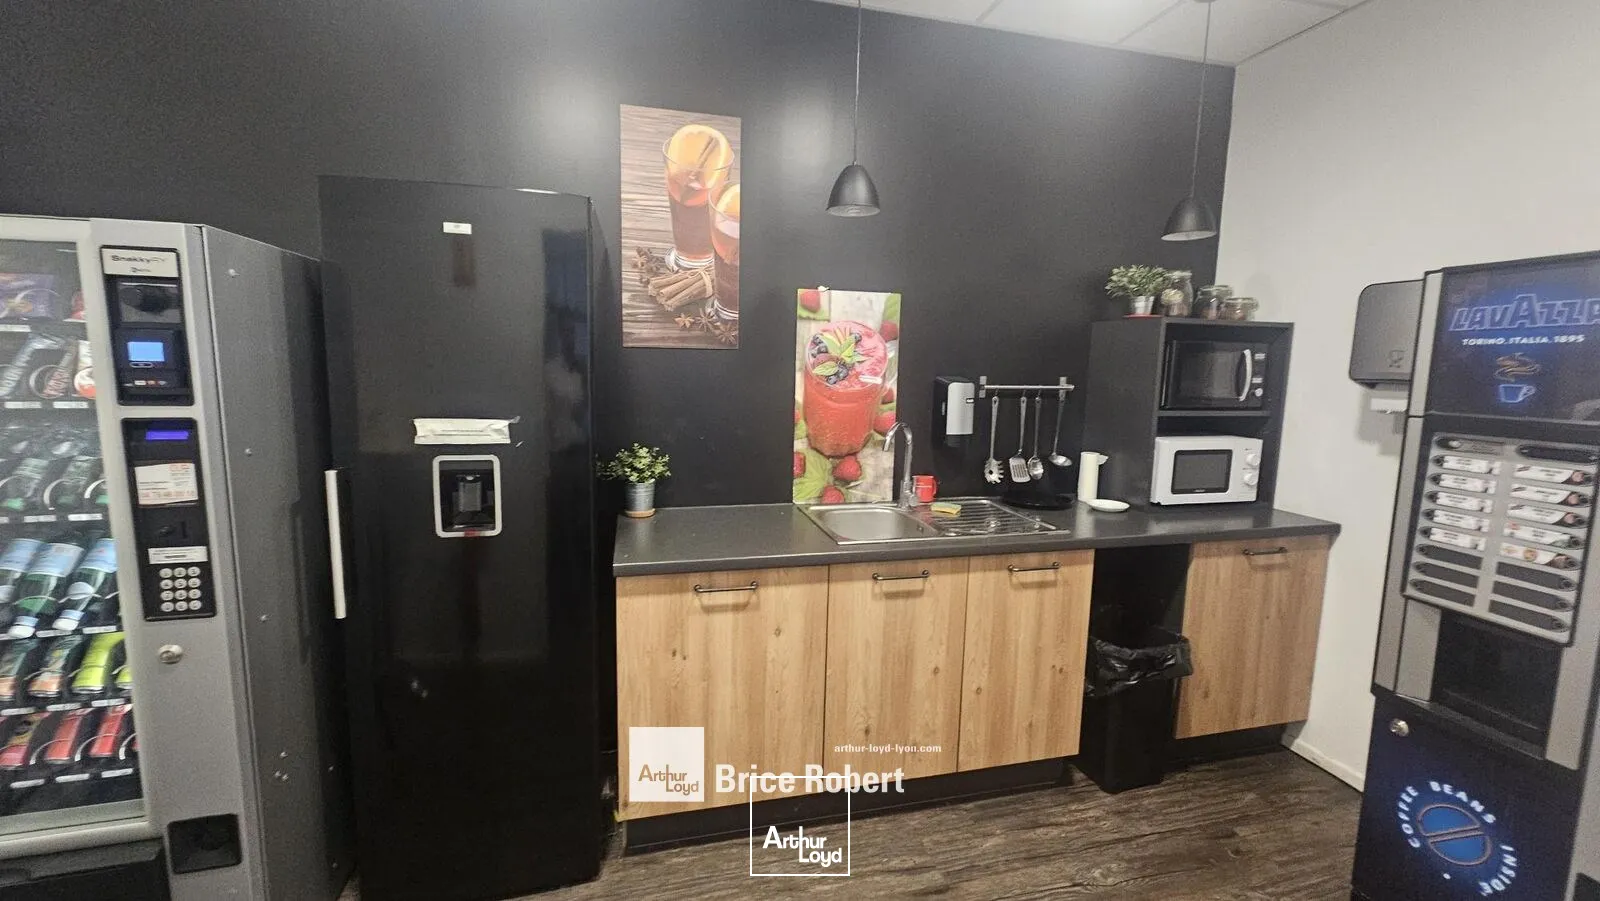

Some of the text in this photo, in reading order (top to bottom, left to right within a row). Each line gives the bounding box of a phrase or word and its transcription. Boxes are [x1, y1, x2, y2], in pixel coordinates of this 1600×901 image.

[1398, 786, 1421, 848] COFFEE
[1429, 781, 1497, 824] BEANS
[1479, 844, 1518, 897] INSIDE
